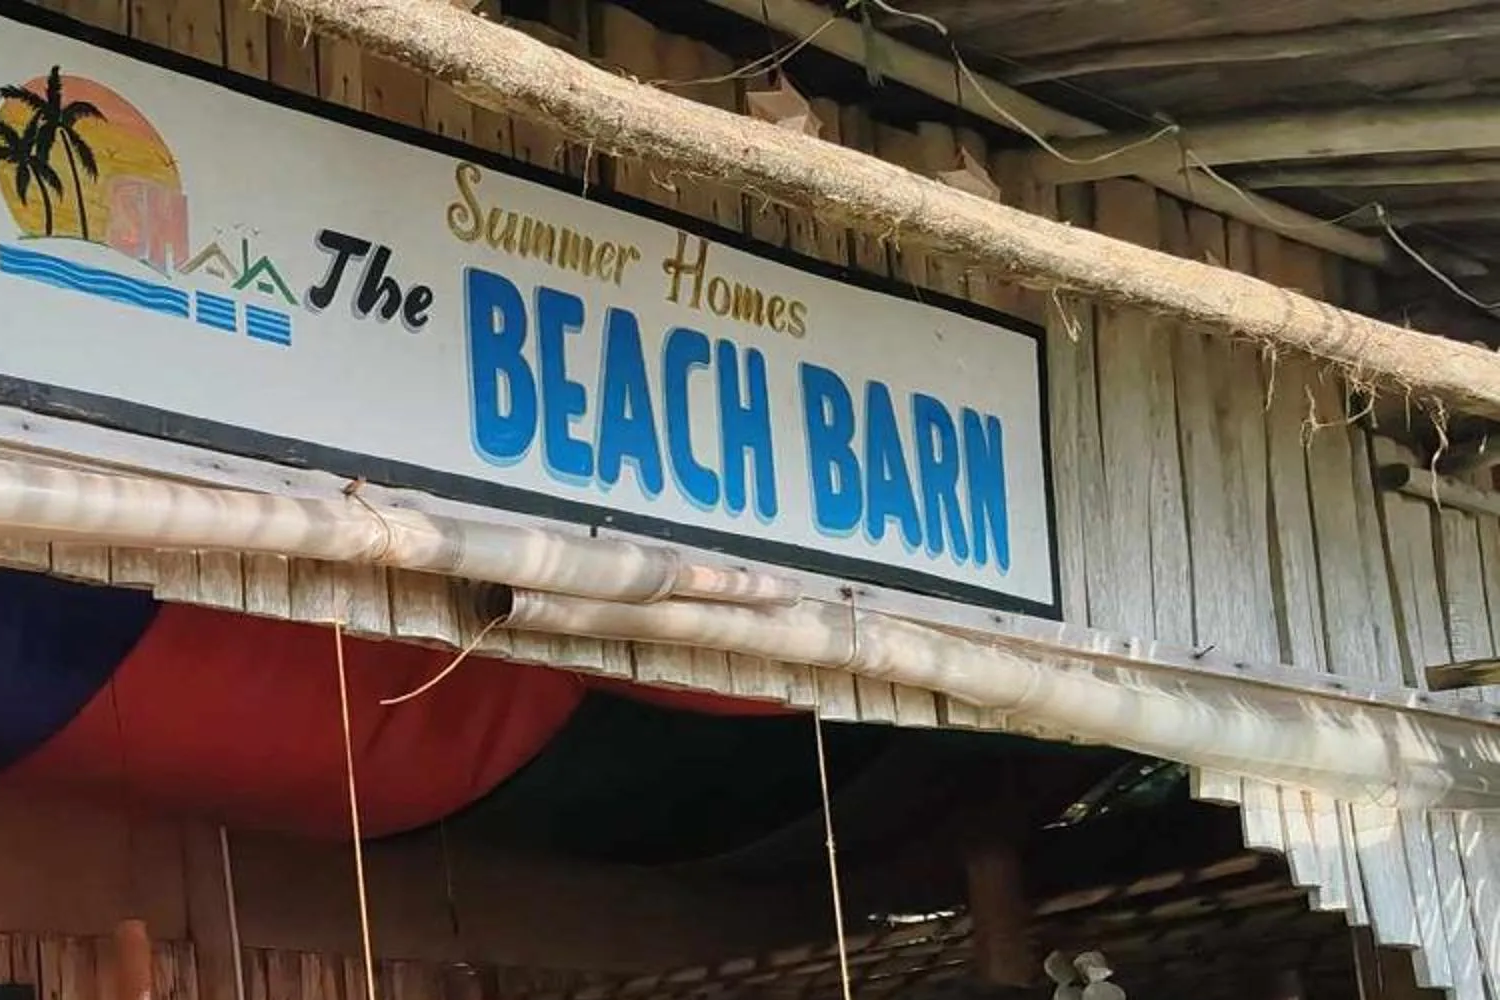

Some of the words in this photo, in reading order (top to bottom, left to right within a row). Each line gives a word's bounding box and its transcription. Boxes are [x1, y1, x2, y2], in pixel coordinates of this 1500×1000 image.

[304, 228, 434, 332] The
[446, 163, 641, 288] Summer
[661, 231, 808, 340] Homes
[463, 266, 779, 525] BEACH
[799, 361, 1011, 575] BARN
